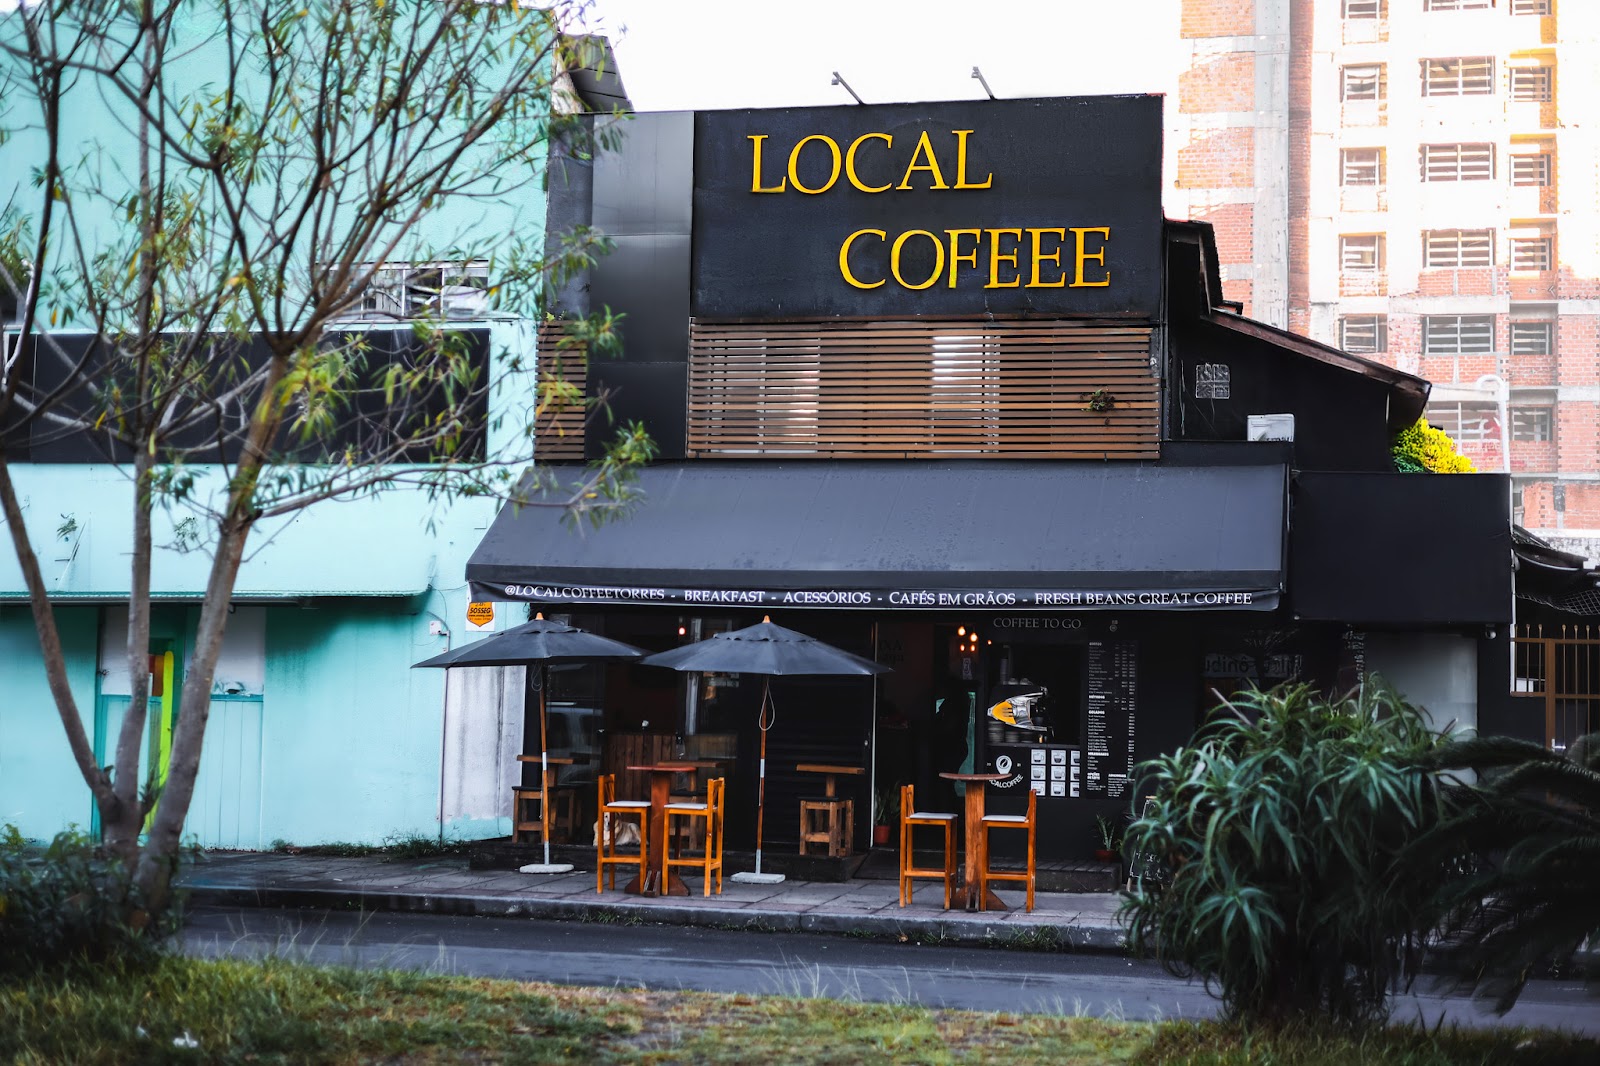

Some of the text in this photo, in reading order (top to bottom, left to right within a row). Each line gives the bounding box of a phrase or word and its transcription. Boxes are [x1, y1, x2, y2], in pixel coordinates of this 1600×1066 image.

[747, 129, 993, 194] LOCAL
[838, 226, 1111, 290] COFEEE
[504, 584, 665, 600] @LOCALCOFFEETORRES
[683, 589, 766, 604] BREAKFAST
[783, 589, 872, 605] ACESSÓRIOS
[888, 589, 936, 606] CAFÉS
[938, 592, 962, 606] EM
[963, 589, 1016, 606] GRÃOS
[1034, 592, 1082, 607] FRESH
[1084, 592, 1137, 607] BEANS
[1138, 592, 1192, 606] GREAT
[1193, 592, 1253, 606] COFFEE
[993, 617, 1082, 629] COFFEE TO GO
